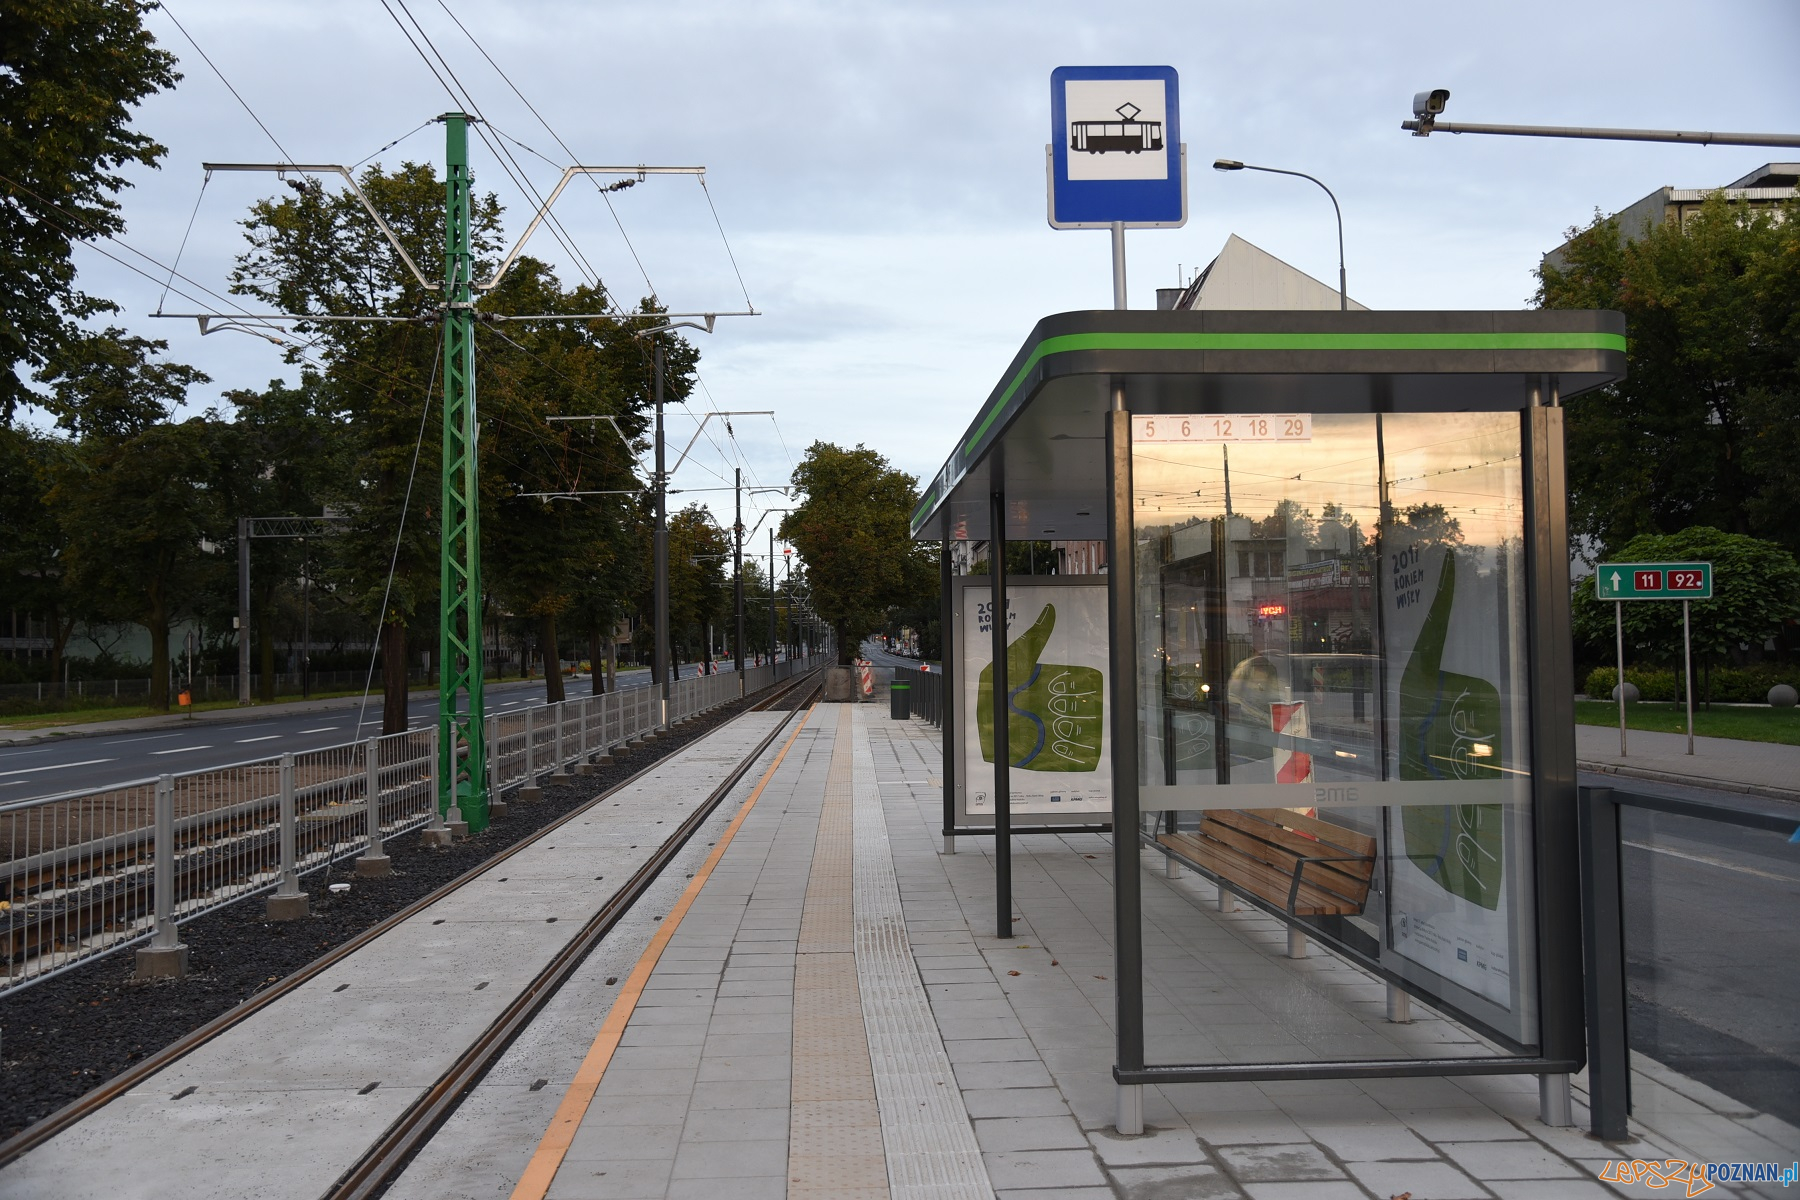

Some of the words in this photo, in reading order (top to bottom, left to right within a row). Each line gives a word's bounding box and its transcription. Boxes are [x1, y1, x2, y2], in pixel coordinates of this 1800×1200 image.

[1145, 420, 1155, 438] 5
[1181, 420, 1191, 437] 6
[1213, 419, 1232, 437] 12
[1248, 419, 1268, 437] 18
[1284, 419, 1304, 436] 29
[1393, 568, 1424, 592] ROKIEM
[1641, 574, 1654, 588] 11
[1675, 573, 1695, 588] 92
[978, 612, 1016, 623] ROM
